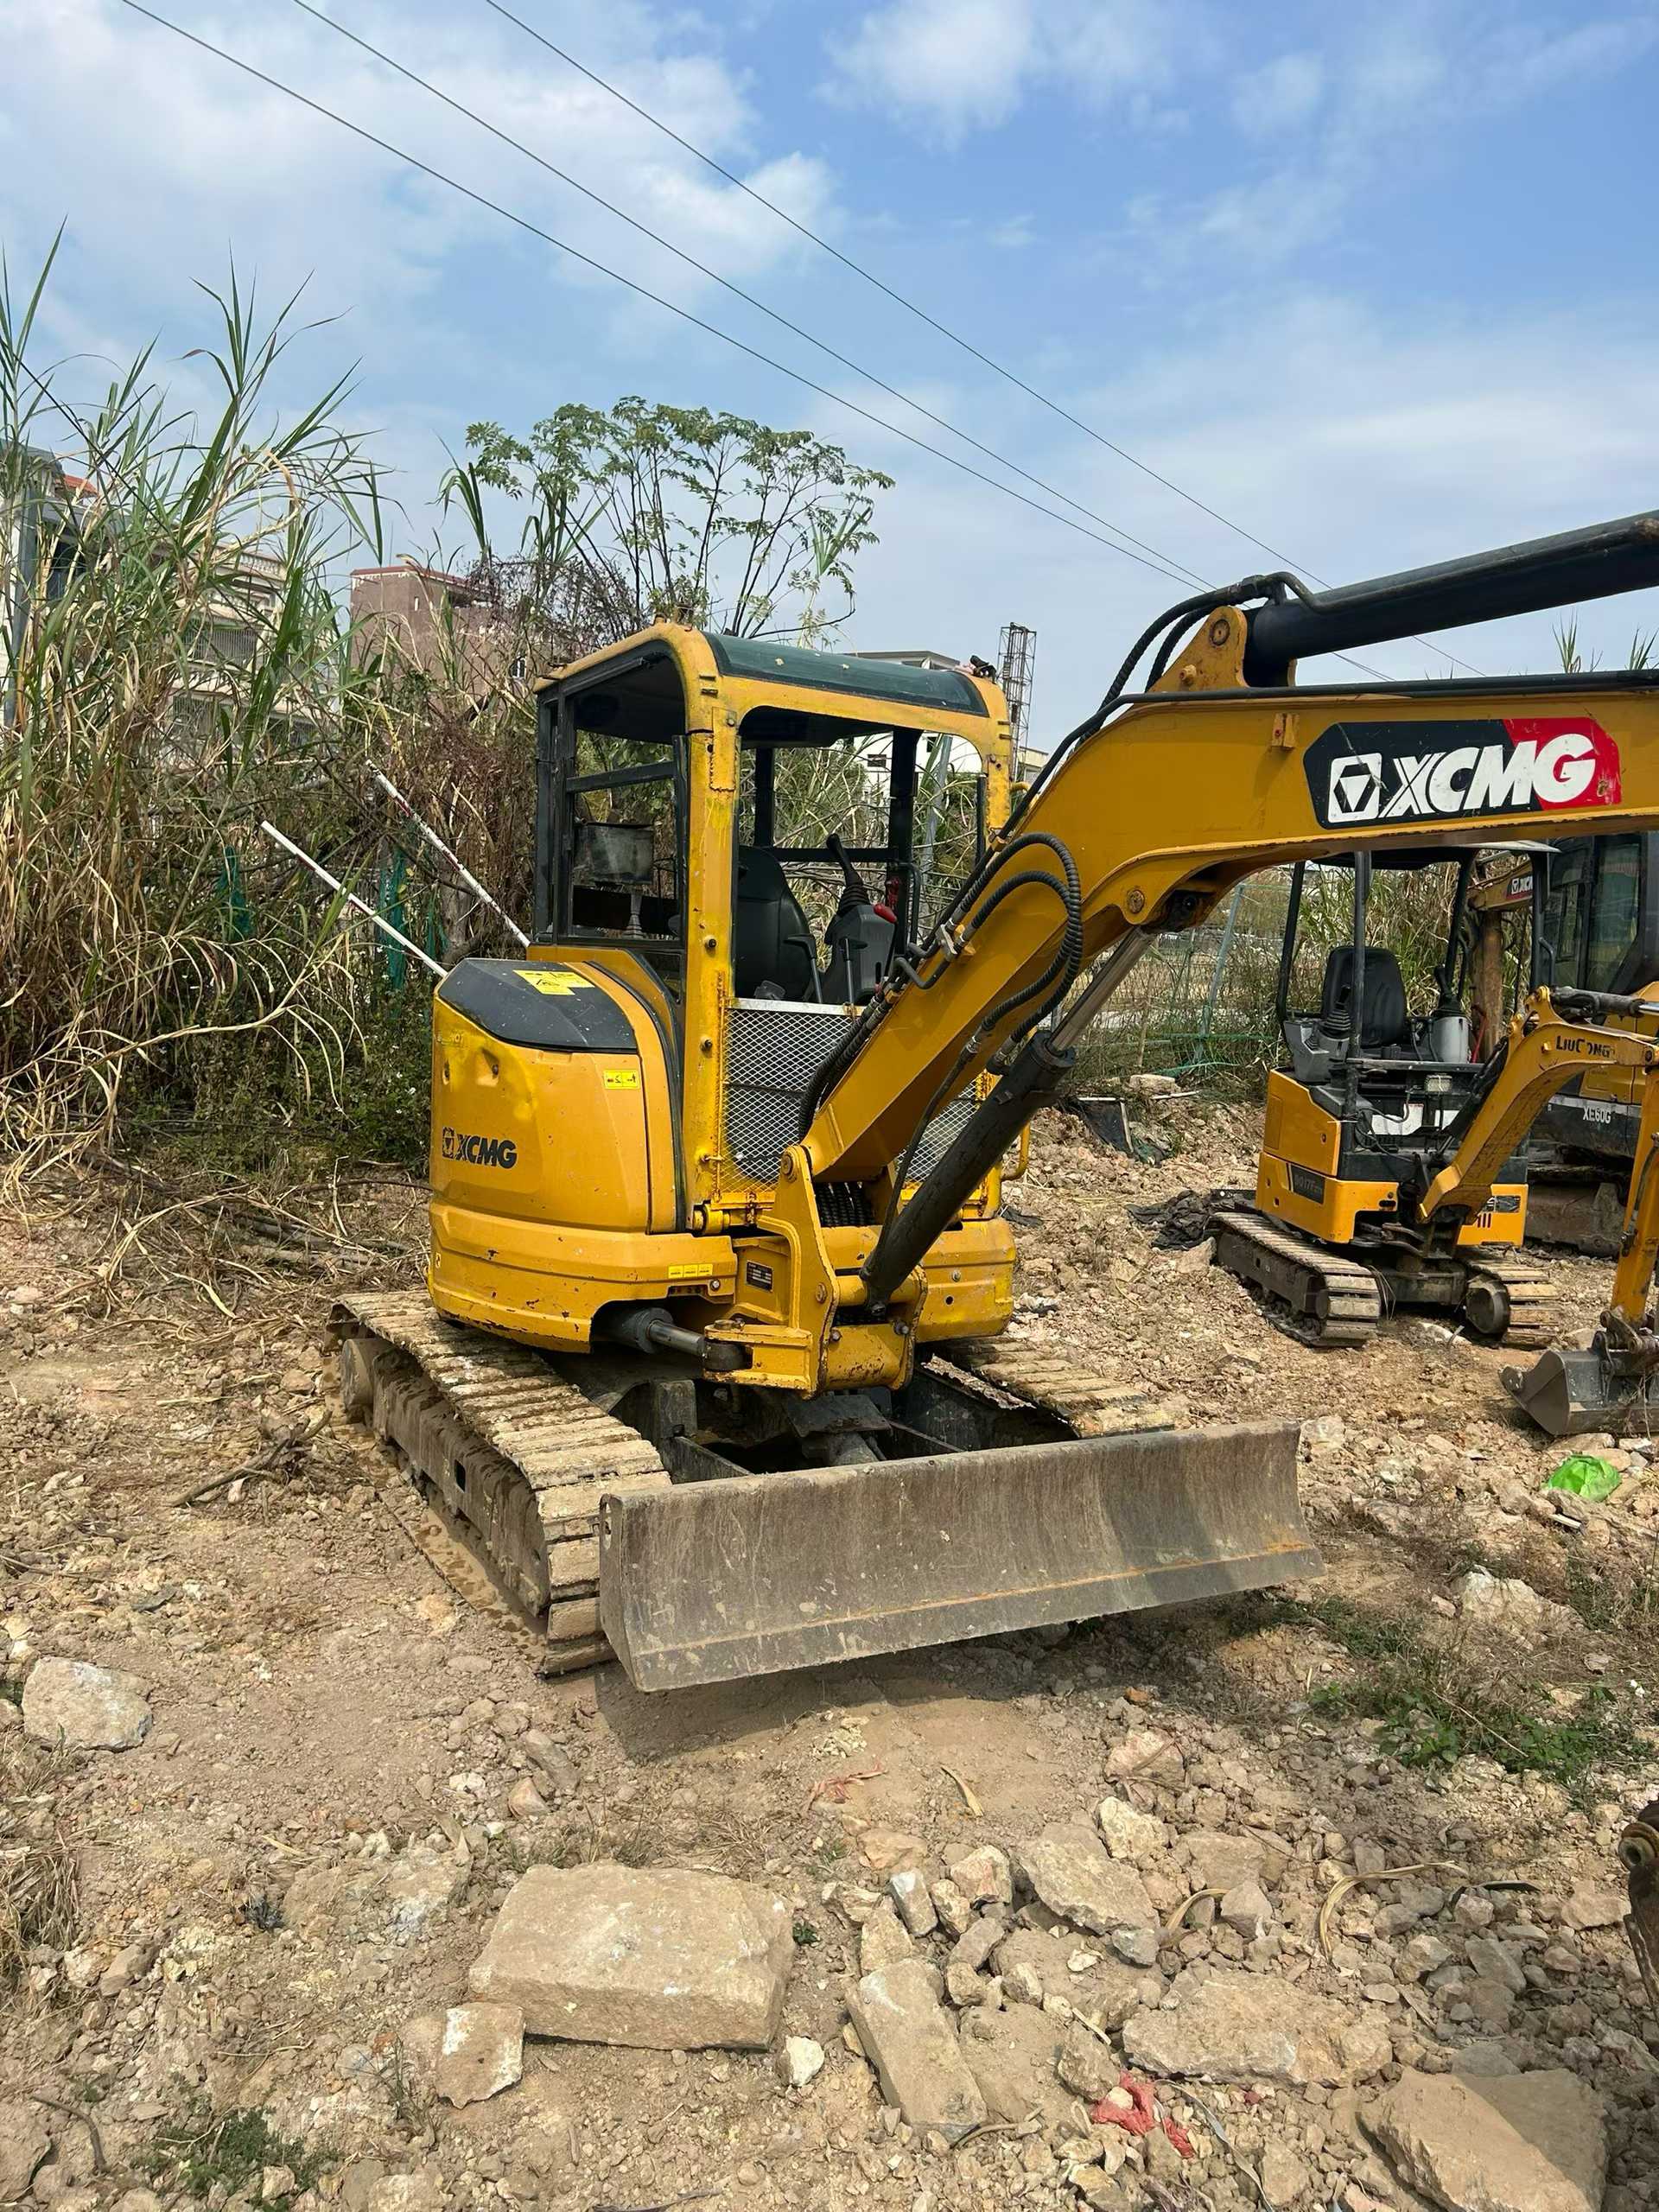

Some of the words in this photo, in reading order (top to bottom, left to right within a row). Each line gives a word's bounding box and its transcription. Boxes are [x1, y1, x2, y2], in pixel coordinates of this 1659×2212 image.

[1378, 734, 1595, 818] XCMG
[1582, 1106, 1611, 1124] XE60G
[455, 1133, 518, 1169] XCMG
